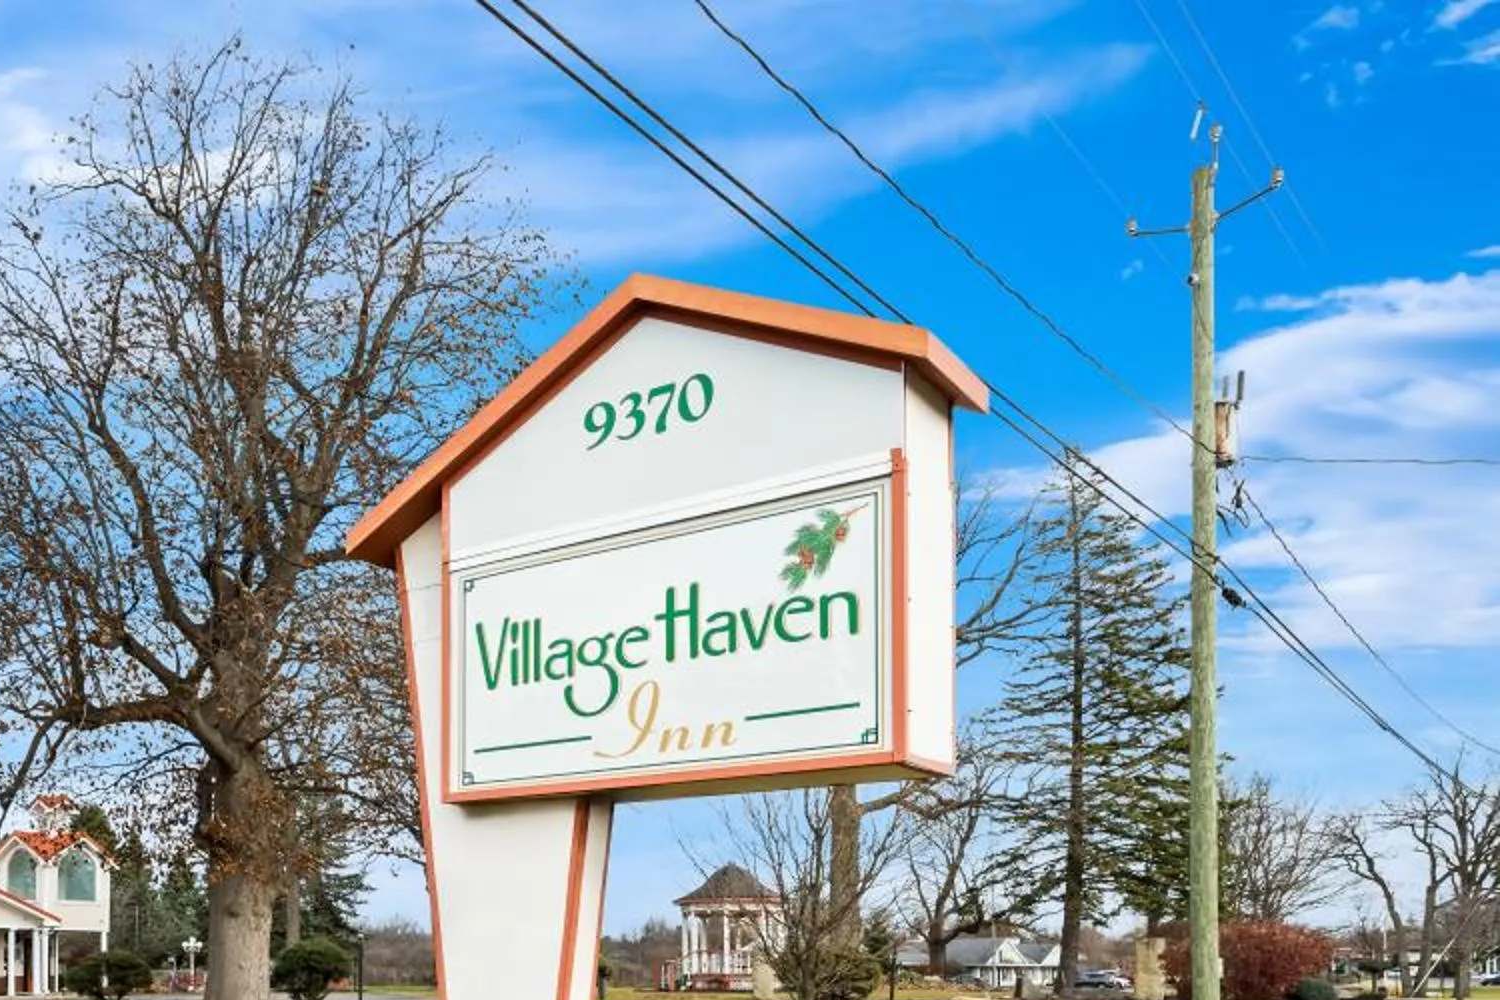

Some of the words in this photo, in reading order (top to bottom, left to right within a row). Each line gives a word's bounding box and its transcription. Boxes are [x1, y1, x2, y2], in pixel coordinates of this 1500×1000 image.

[583, 372, 714, 450] 9370
[475, 616, 649, 716] Village
[655, 582, 860, 662] Haven
[594, 680, 737, 757] Inn
